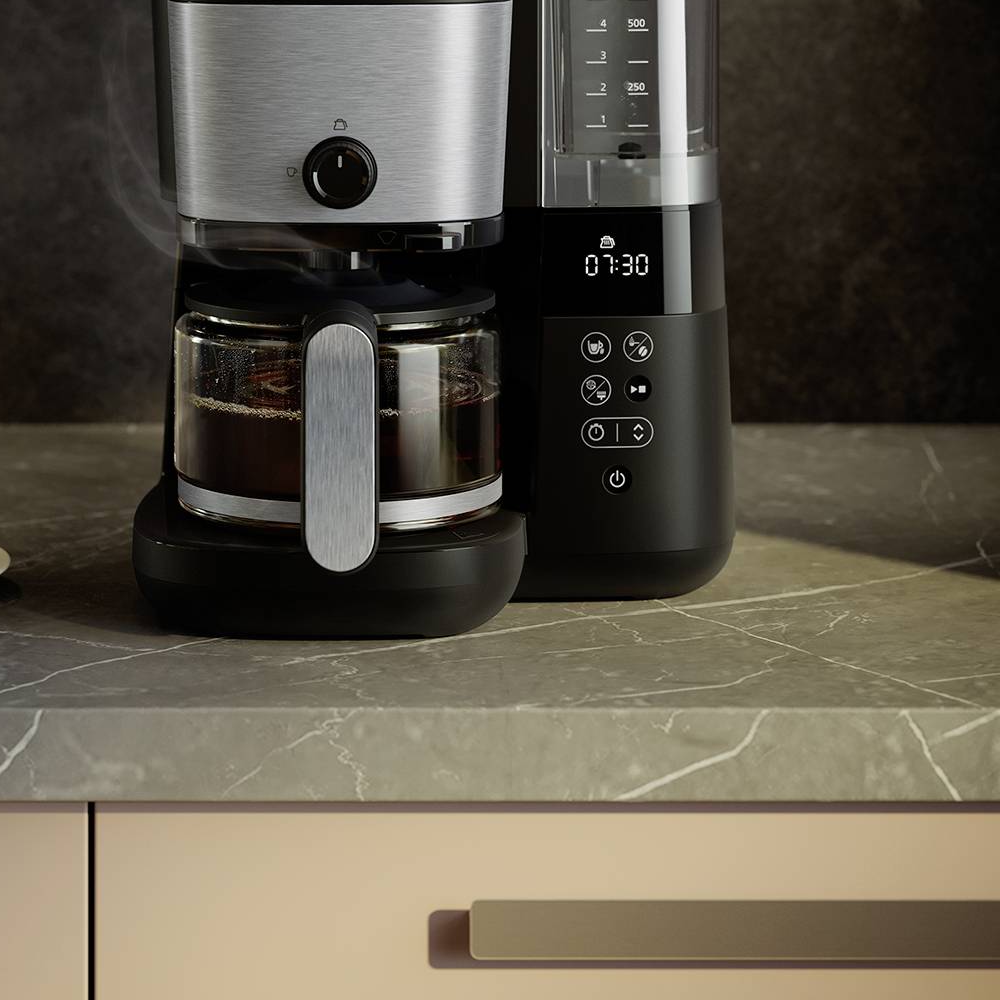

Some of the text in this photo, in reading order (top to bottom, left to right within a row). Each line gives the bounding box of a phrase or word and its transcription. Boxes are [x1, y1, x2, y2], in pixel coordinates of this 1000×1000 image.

[600, 19, 646, 28] 4 500
[600, 51, 607, 60] 3
[600, 83, 646, 92] 2 250
[601, 115, 606, 123] 1
[585, 253, 649, 276] 07:30
